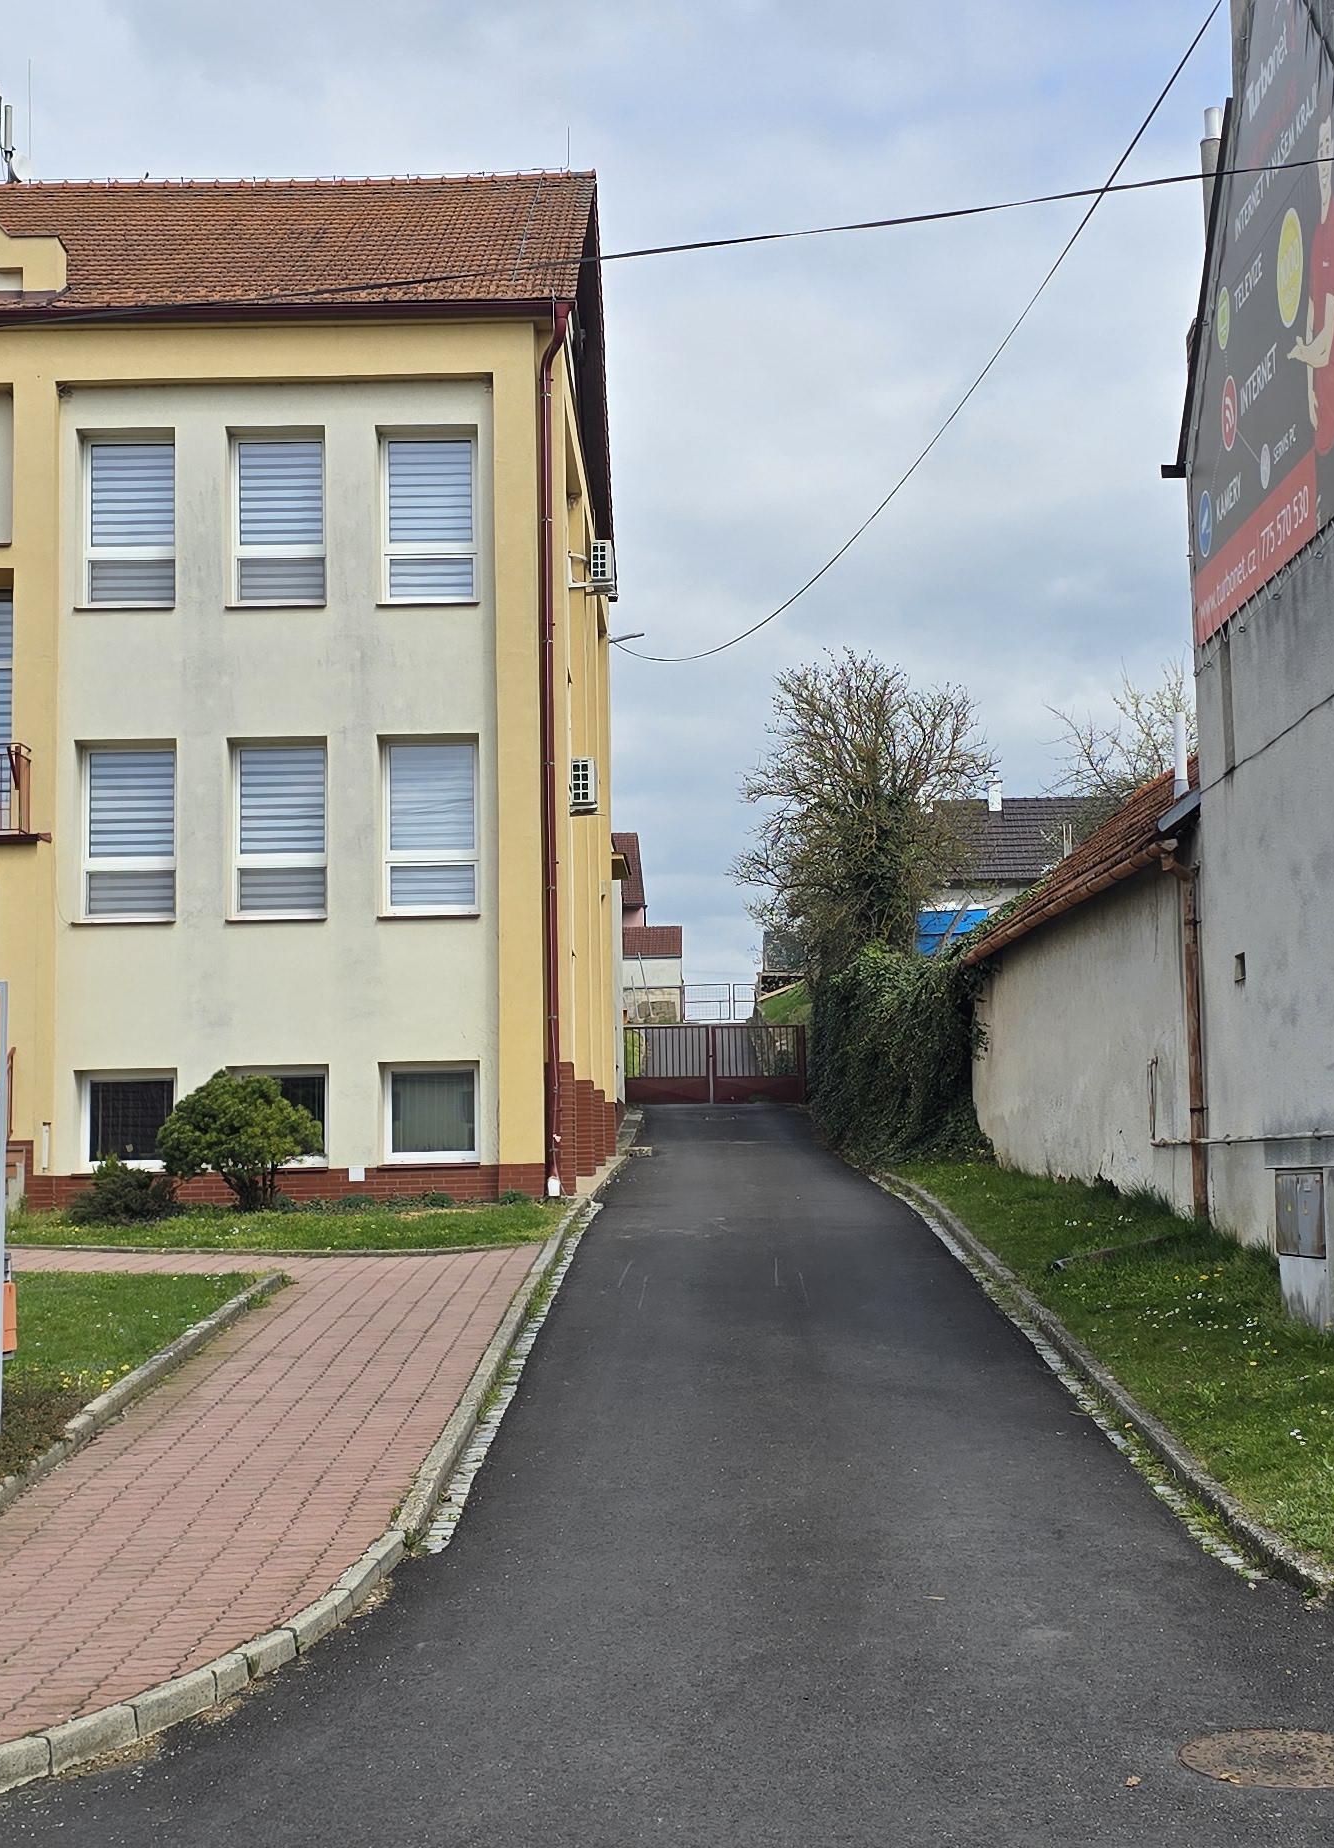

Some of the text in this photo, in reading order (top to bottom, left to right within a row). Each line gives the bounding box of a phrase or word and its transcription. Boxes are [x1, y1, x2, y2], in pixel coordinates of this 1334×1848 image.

[1246, 21, 1287, 122] Turbonet
[1234, 172, 1264, 242] INTERNET
[1233, 252, 1262, 312] TELEVIZE
[1240, 342, 1277, 416] INTERNET
[1273, 433, 1289, 464] SERVIS
[1217, 472, 1241, 523] KAMERY
[1261, 521, 1275, 561] 775
[1276, 504, 1292, 545] 570
[1293, 485, 1309, 528] 530
